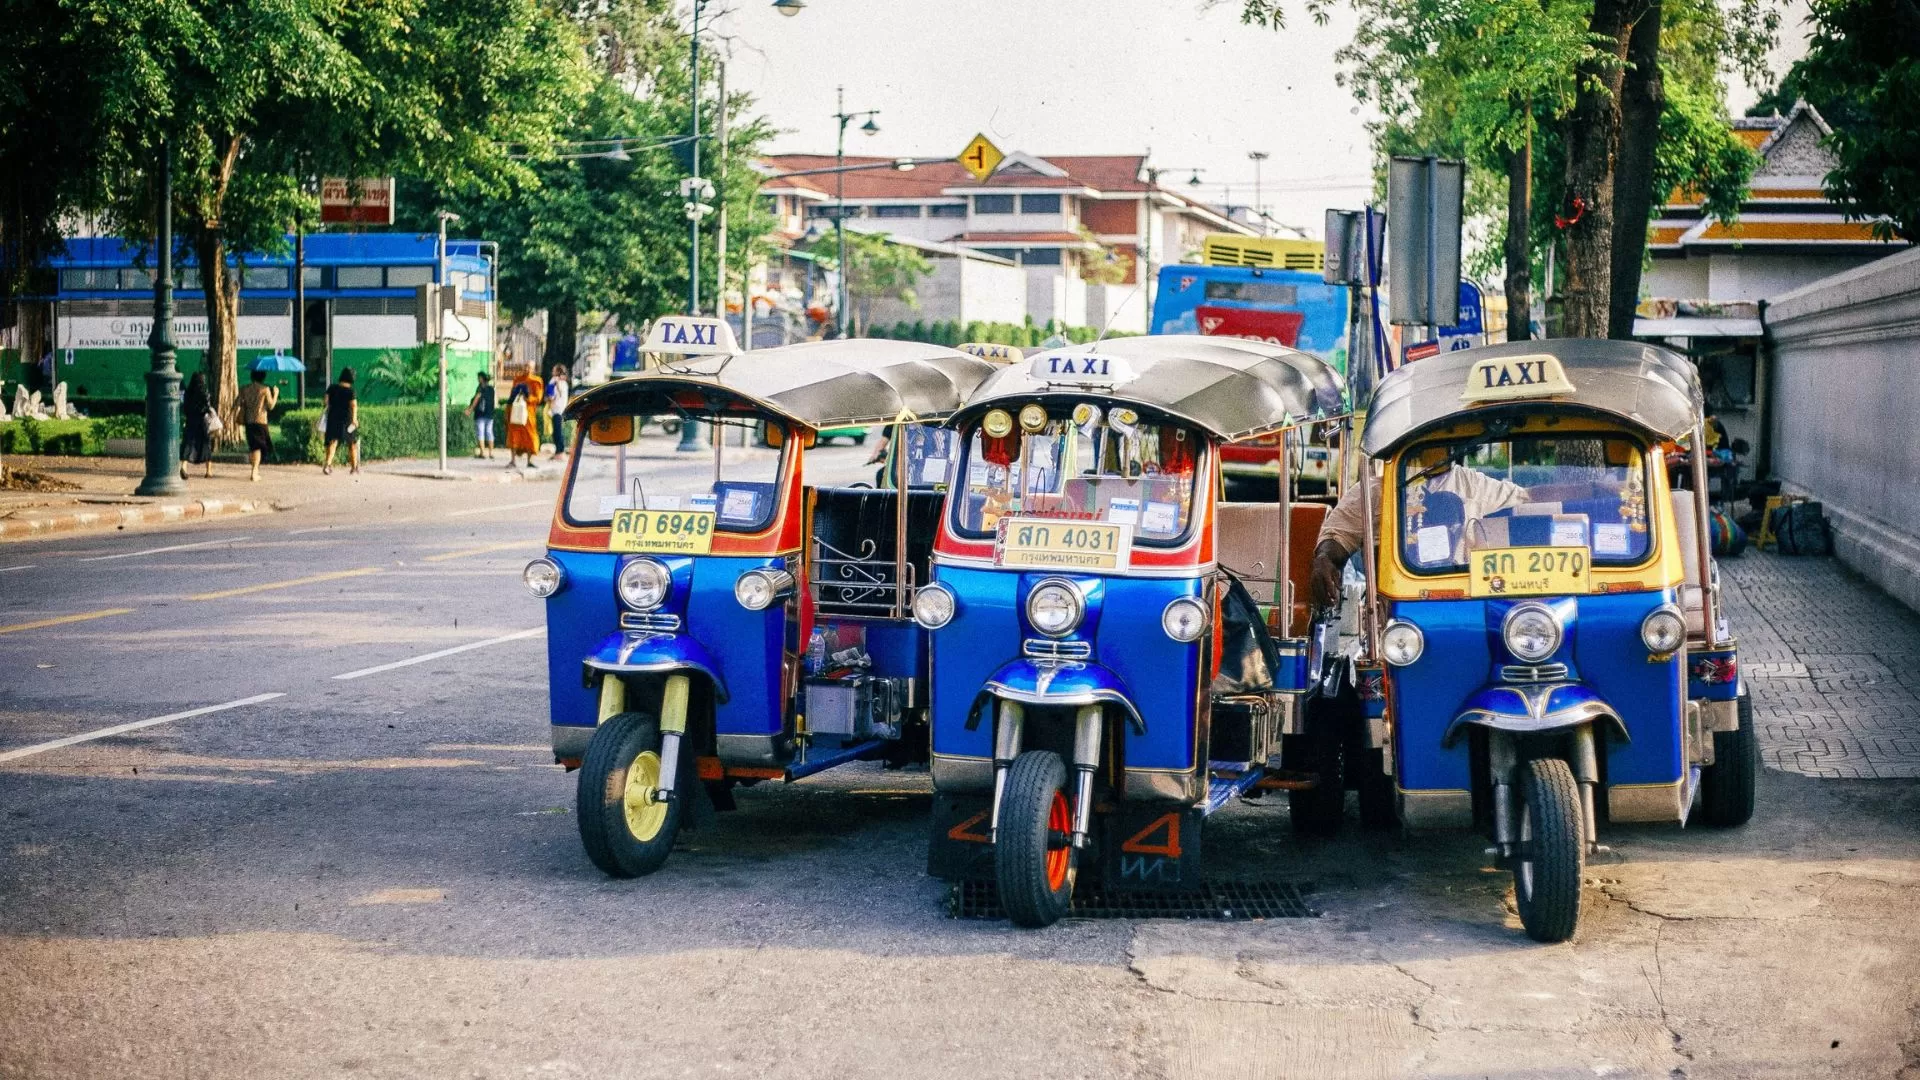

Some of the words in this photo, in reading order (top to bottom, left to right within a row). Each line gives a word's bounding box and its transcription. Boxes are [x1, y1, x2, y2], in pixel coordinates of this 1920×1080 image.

[78, 338, 121, 347] BANGKOK
[660, 322, 718, 345] TAXI
[967, 345, 1009, 357] TAXI
[1048, 357, 1110, 375] TAXI
[1479, 360, 1548, 388] TAXI
[616, 511, 649, 534] สก
[656, 514, 709, 536] 6949
[625, 540, 694, 550] กรุงเทพมหานคร
[1018, 525, 1050, 547] สก
[1062, 528, 1114, 551] 4031
[1020, 553, 1100, 565] กรุงเทพมหานคร
[1482, 552, 1515, 575] สก
[1528, 551, 1584, 575] 2070
[1510, 577, 1550, 593] นนทบุรี
[1121, 812, 1183, 858] 4
